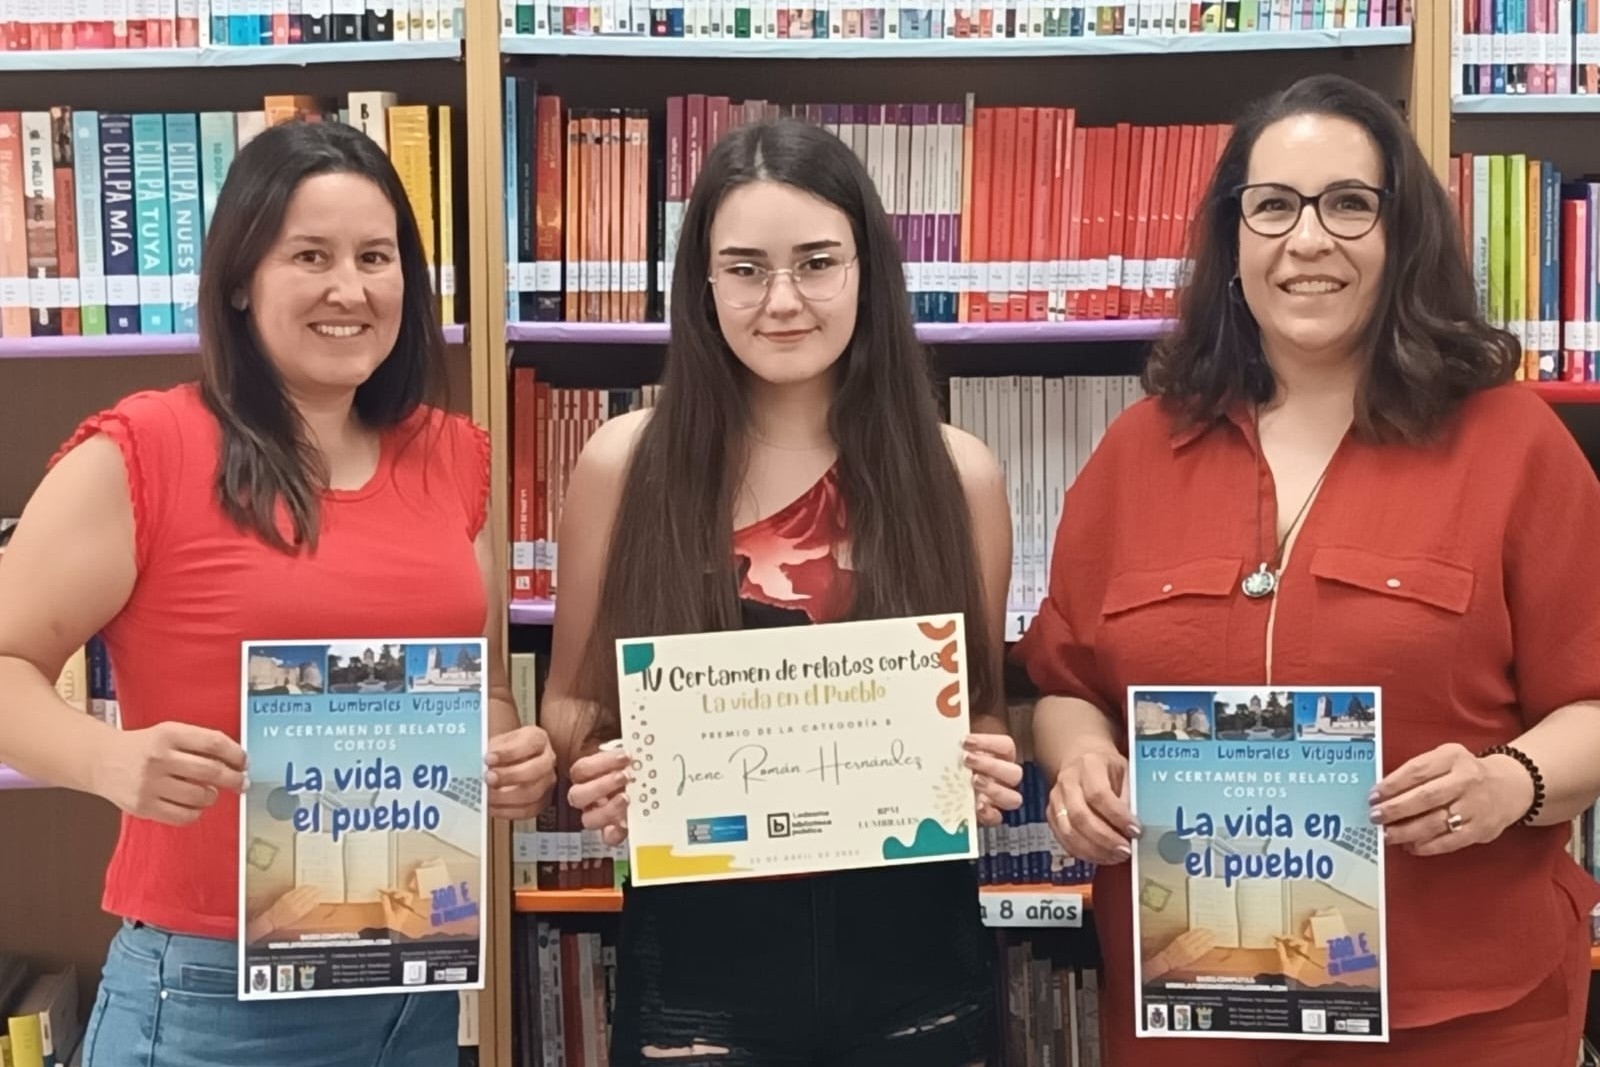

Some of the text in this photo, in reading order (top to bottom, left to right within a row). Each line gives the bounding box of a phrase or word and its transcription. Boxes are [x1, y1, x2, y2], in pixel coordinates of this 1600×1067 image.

[104, 141, 132, 204] CULPA
[169, 141, 198, 204] CULPA
[136, 140, 164, 270] CULPA TUYA
[109, 209, 131, 256] MÍA
[641, 650, 942, 692] IV Certamen de relatos cortos
[253, 696, 481, 716] Ledesma Lumbrales Vitigudino
[702, 679, 887, 714] La vida en el Pueblo
[263, 722, 467, 738] IV CERTAMEN DE RELATOS
[333, 738, 398, 752] CORTOS
[701, 718, 893, 740] PREMIO DE LA CATEGORÍA B
[673, 739, 923, 797] Irene Román Hernández
[1141, 745, 1375, 765] Ledesma Lumbrales Vitigudino
[285, 757, 451, 794] La vida en
[1152, 770, 1360, 784] IV CERTAMEN DE RELATOS
[1223, 785, 1288, 799] CORTOS
[292, 798, 441, 843] el pueblo
[773, 816, 785, 833] b
[1176, 805, 1343, 841] La vida en
[1185, 848, 1335, 889] el pueblo
[1000, 899, 1014, 919] 8
[1025, 899, 1078, 921] años
